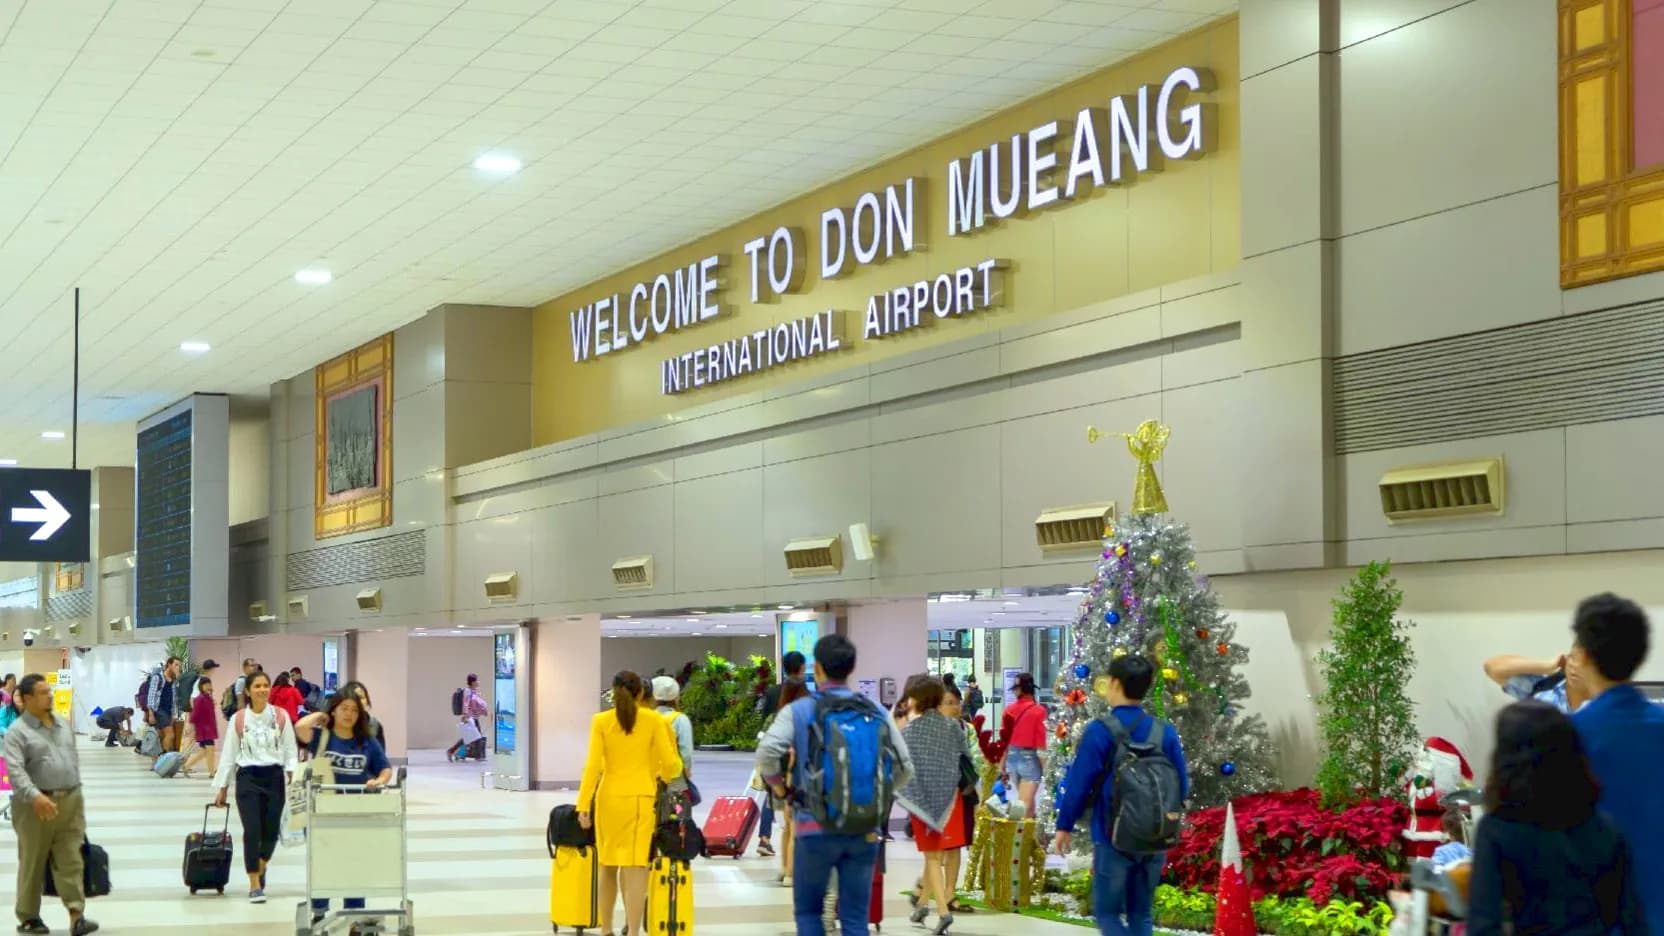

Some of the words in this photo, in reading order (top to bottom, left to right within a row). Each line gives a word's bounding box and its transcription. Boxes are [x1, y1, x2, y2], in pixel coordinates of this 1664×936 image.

[569, 256, 720, 362] WELCOME
[743, 226, 794, 303] TO
[820, 178, 915, 279] DON
[948, 66, 1203, 236] MUEANG
[660, 310, 840, 394] INTERNATIONAL
[863, 258, 996, 339] AIRPORT
